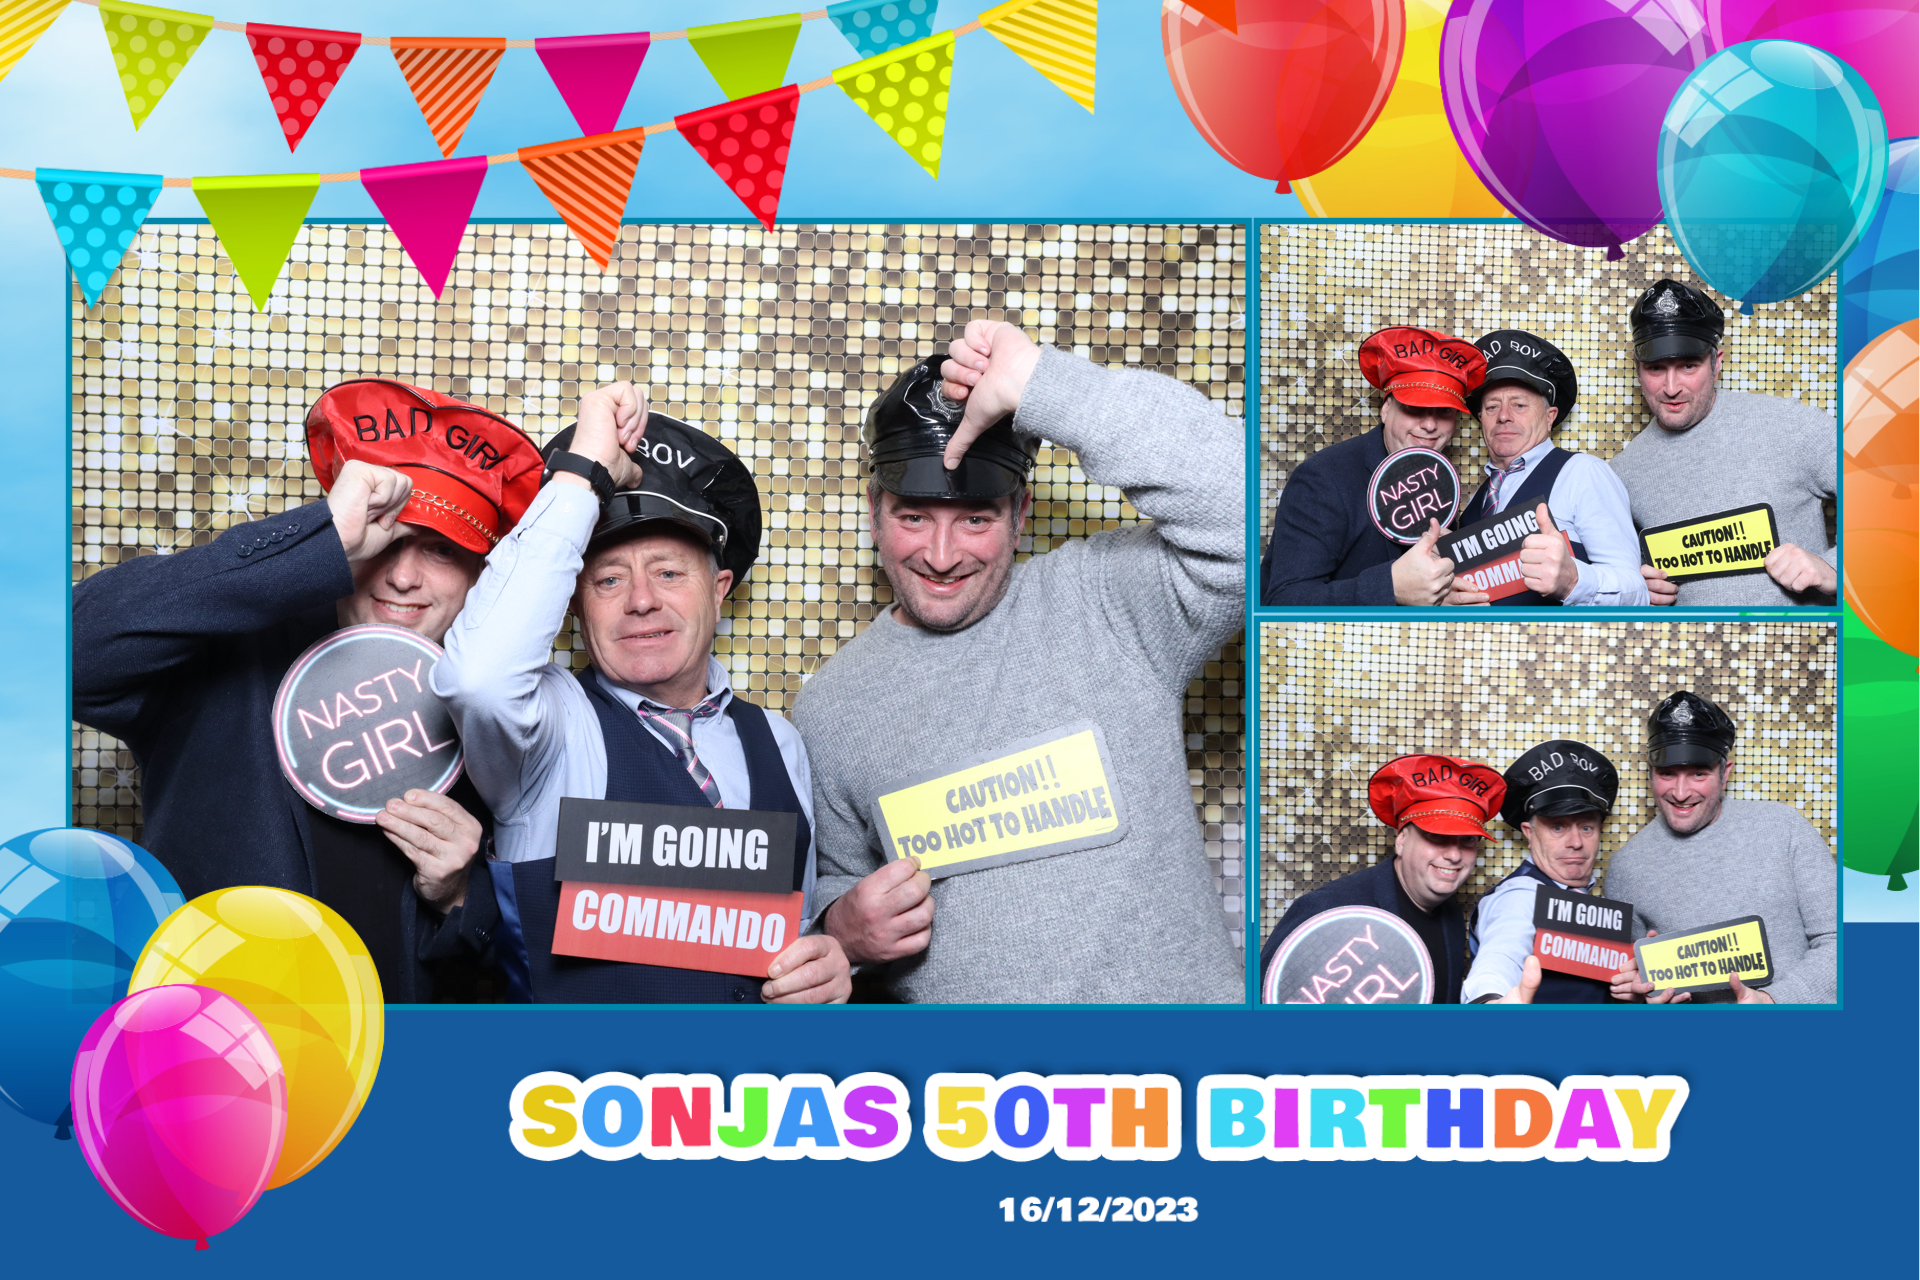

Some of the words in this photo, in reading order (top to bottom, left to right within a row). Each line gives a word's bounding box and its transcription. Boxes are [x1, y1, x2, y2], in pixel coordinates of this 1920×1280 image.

[1394, 339, 1434, 359] BAD
[1482, 340, 1502, 362] AD
[353, 406, 433, 442] BAD
[1379, 462, 1439, 507] NASTY
[1391, 488, 1453, 530] GIRL
[1451, 534, 1483, 564] I'M
[1481, 510, 1540, 551] GOING
[1681, 520, 1747, 549] CAUTION!!
[1654, 556, 1679, 570] TOO
[1680, 551, 1704, 568] HOT
[1705, 549, 1723, 565] TO
[1723, 540, 1772, 564] HANDLE
[296, 658, 422, 740] NASTY
[321, 709, 455, 790] GIRL
[1528, 752, 1564, 781] BAD
[945, 754, 1061, 814] CAUTION!!
[1412, 765, 1453, 788] BAD
[897, 830, 942, 858] TOO
[943, 816, 987, 850] HOT
[990, 810, 1021, 840] TO
[1021, 785, 1113, 834] HANDLE
[586, 821, 643, 865] I'M
[652, 824, 769, 870] GOING
[572, 889, 786, 953] COMMANDO
[1547, 897, 1573, 923] I'M
[1575, 902, 1623, 931] GOING
[1540, 932, 1628, 970] COMMANDO
[1676, 932, 1740, 960] CAUTION!!
[1648, 967, 1673, 982] TOO
[1675, 963, 1698, 980] HOT
[1700, 961, 1717, 977] TO
[1717, 952, 1766, 975] HANDLE
